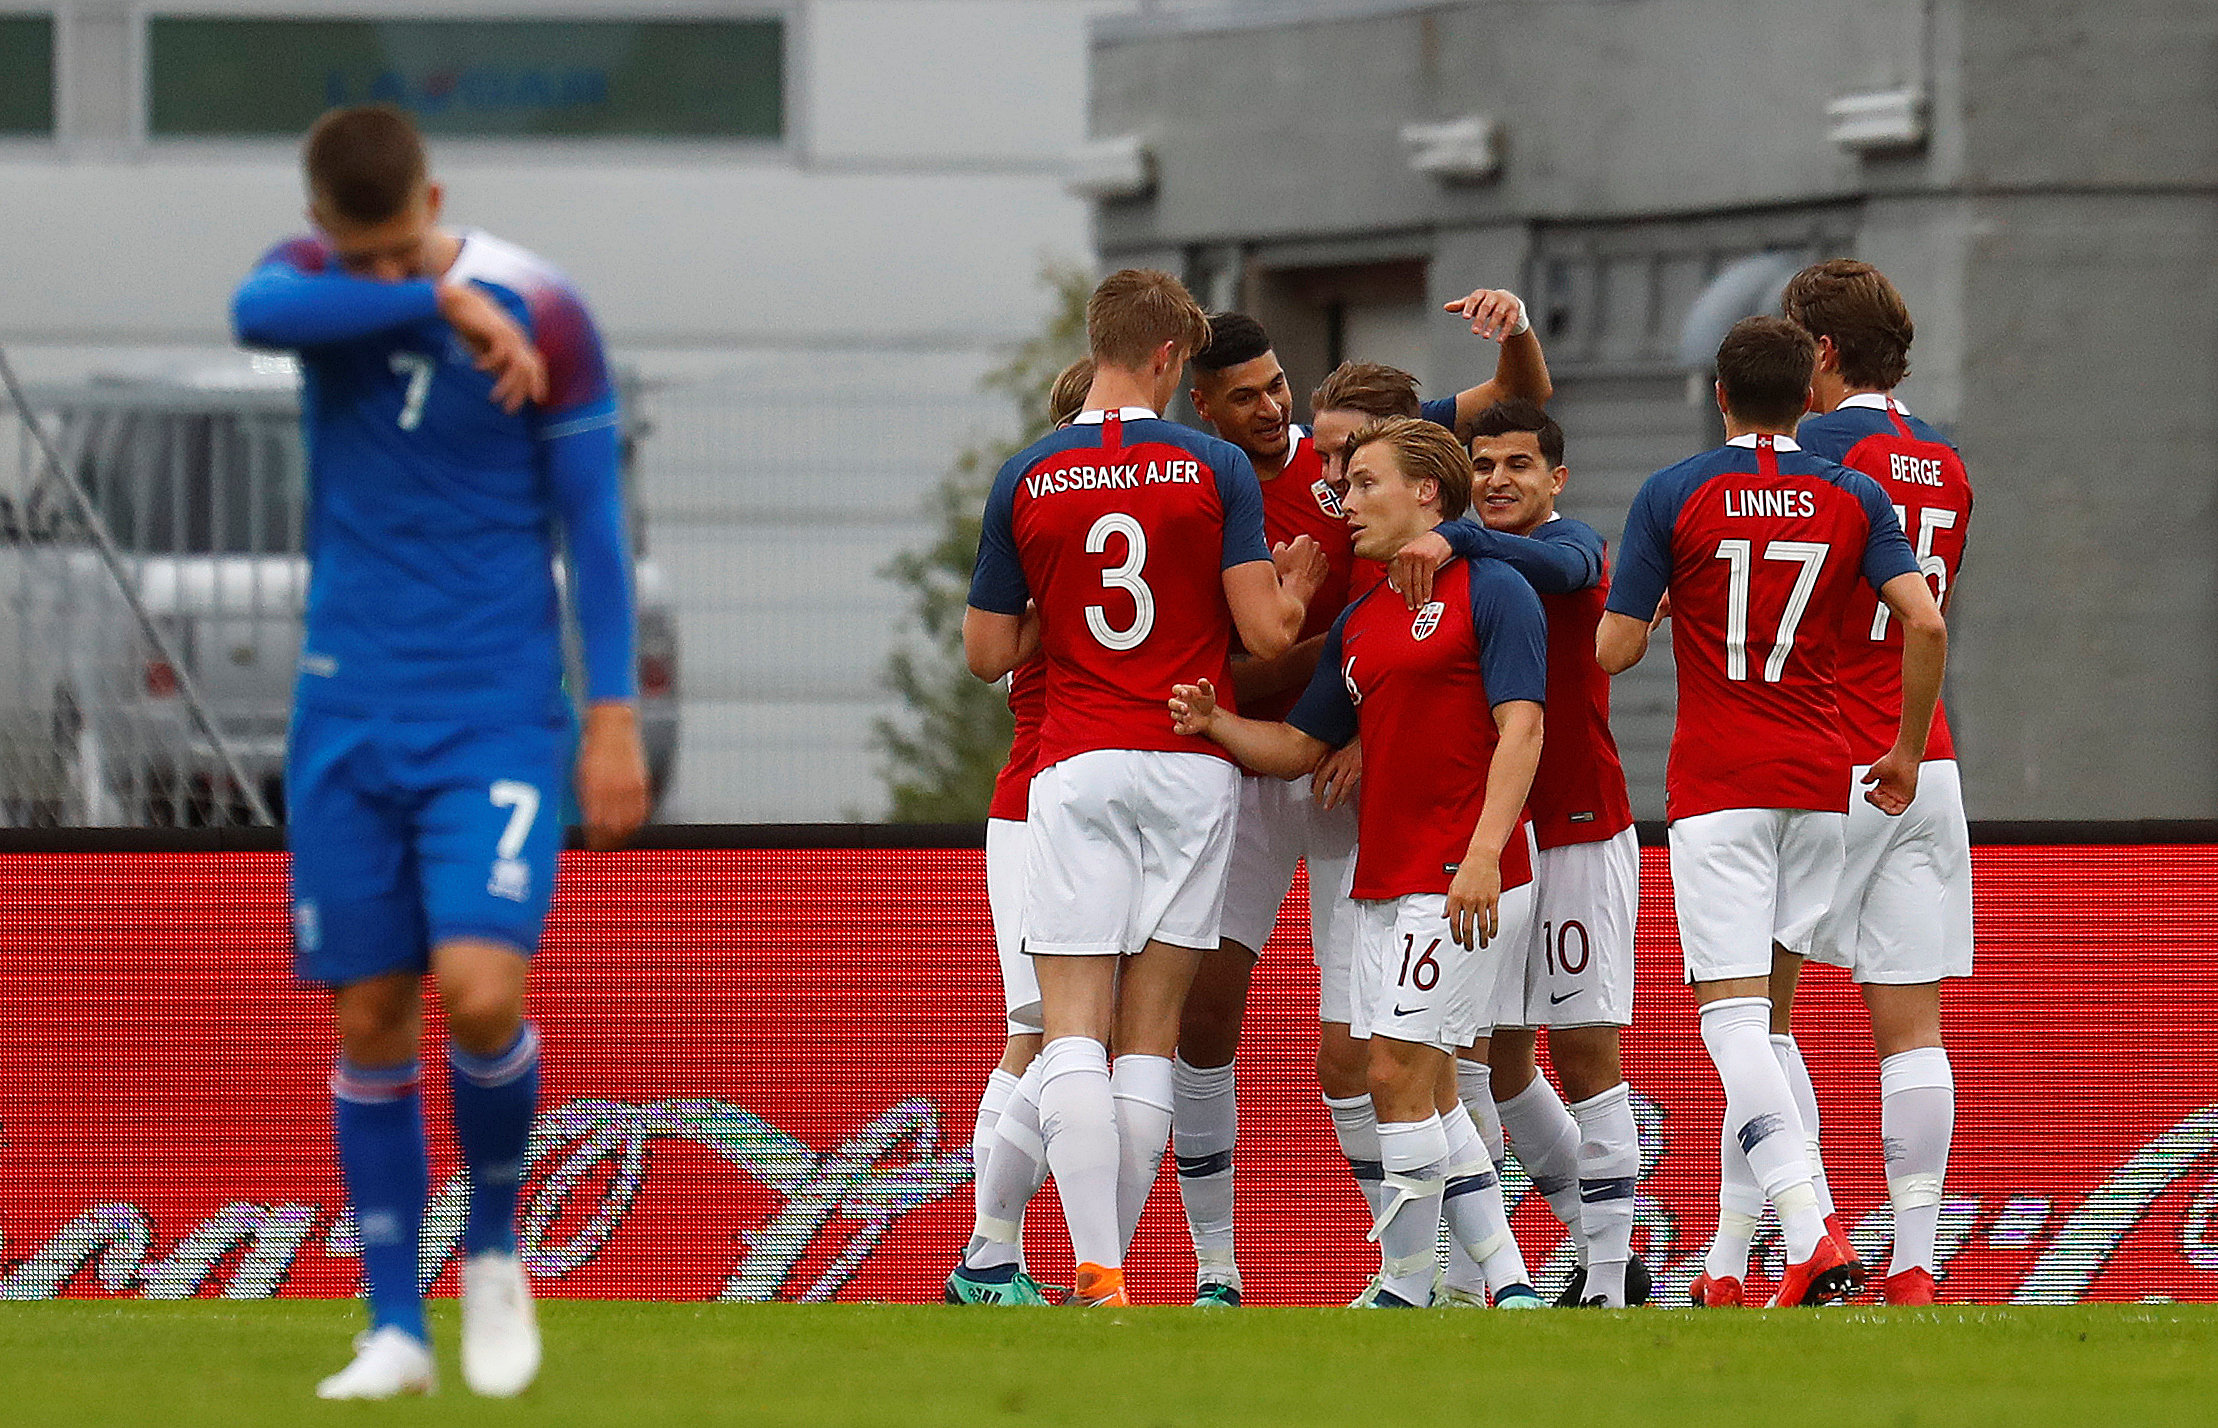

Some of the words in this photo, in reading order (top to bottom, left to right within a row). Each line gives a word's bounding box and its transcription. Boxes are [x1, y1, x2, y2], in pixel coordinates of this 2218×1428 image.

[388, 351, 436, 432] 7
[1025, 463, 1140, 499] VASSBAKK
[1145, 460, 1200, 485] AJER
[1889, 452, 1944, 487] BERGE
[1724, 489, 1816, 518] LINNES
[1084, 512, 1157, 651] 3
[1714, 539, 1831, 683] 17
[489, 779, 542, 860] 7
[1397, 932, 1442, 992] 16
[1542, 919, 1590, 975] 10
